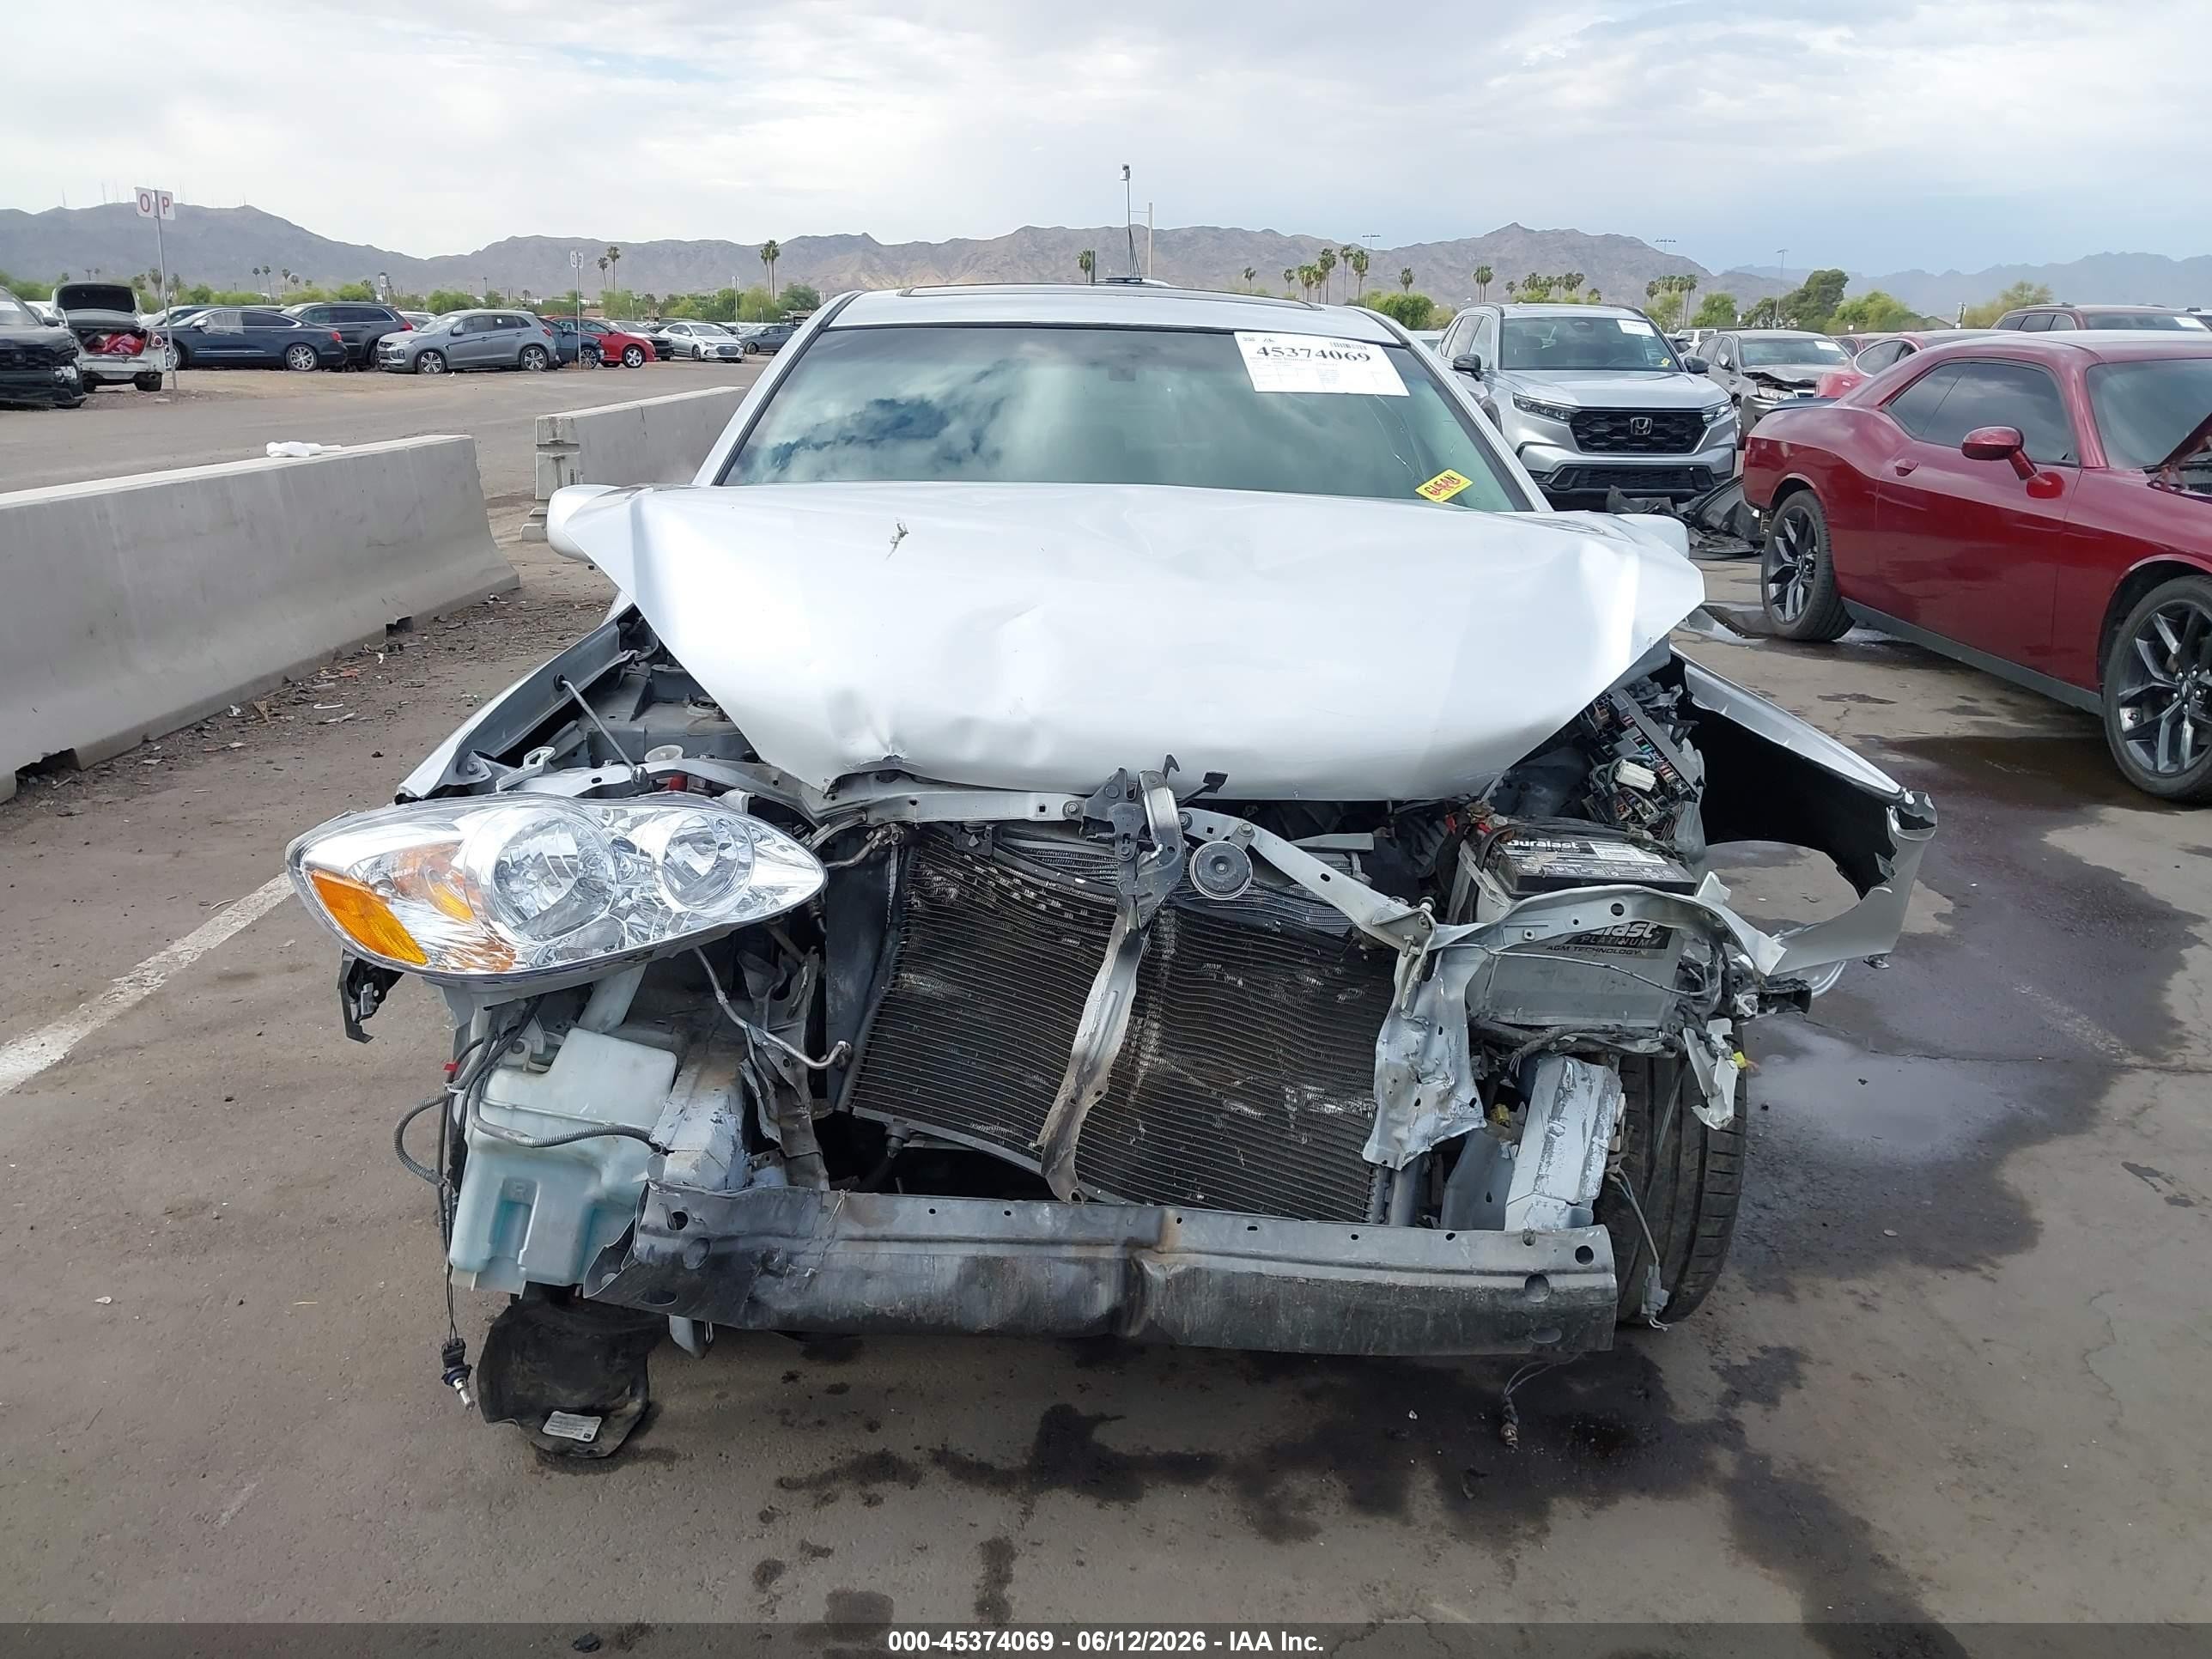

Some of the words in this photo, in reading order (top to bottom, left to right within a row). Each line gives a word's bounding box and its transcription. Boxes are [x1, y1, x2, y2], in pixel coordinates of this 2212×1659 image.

[140, 193, 150, 213] O
[161, 197, 170, 215] P
[1256, 345, 1371, 363] 45374069
[1507, 838, 1579, 850] Duralast
[1580, 934, 1650, 948] PLATINUM
[1573, 946, 1642, 956] TECHNOLOGY
